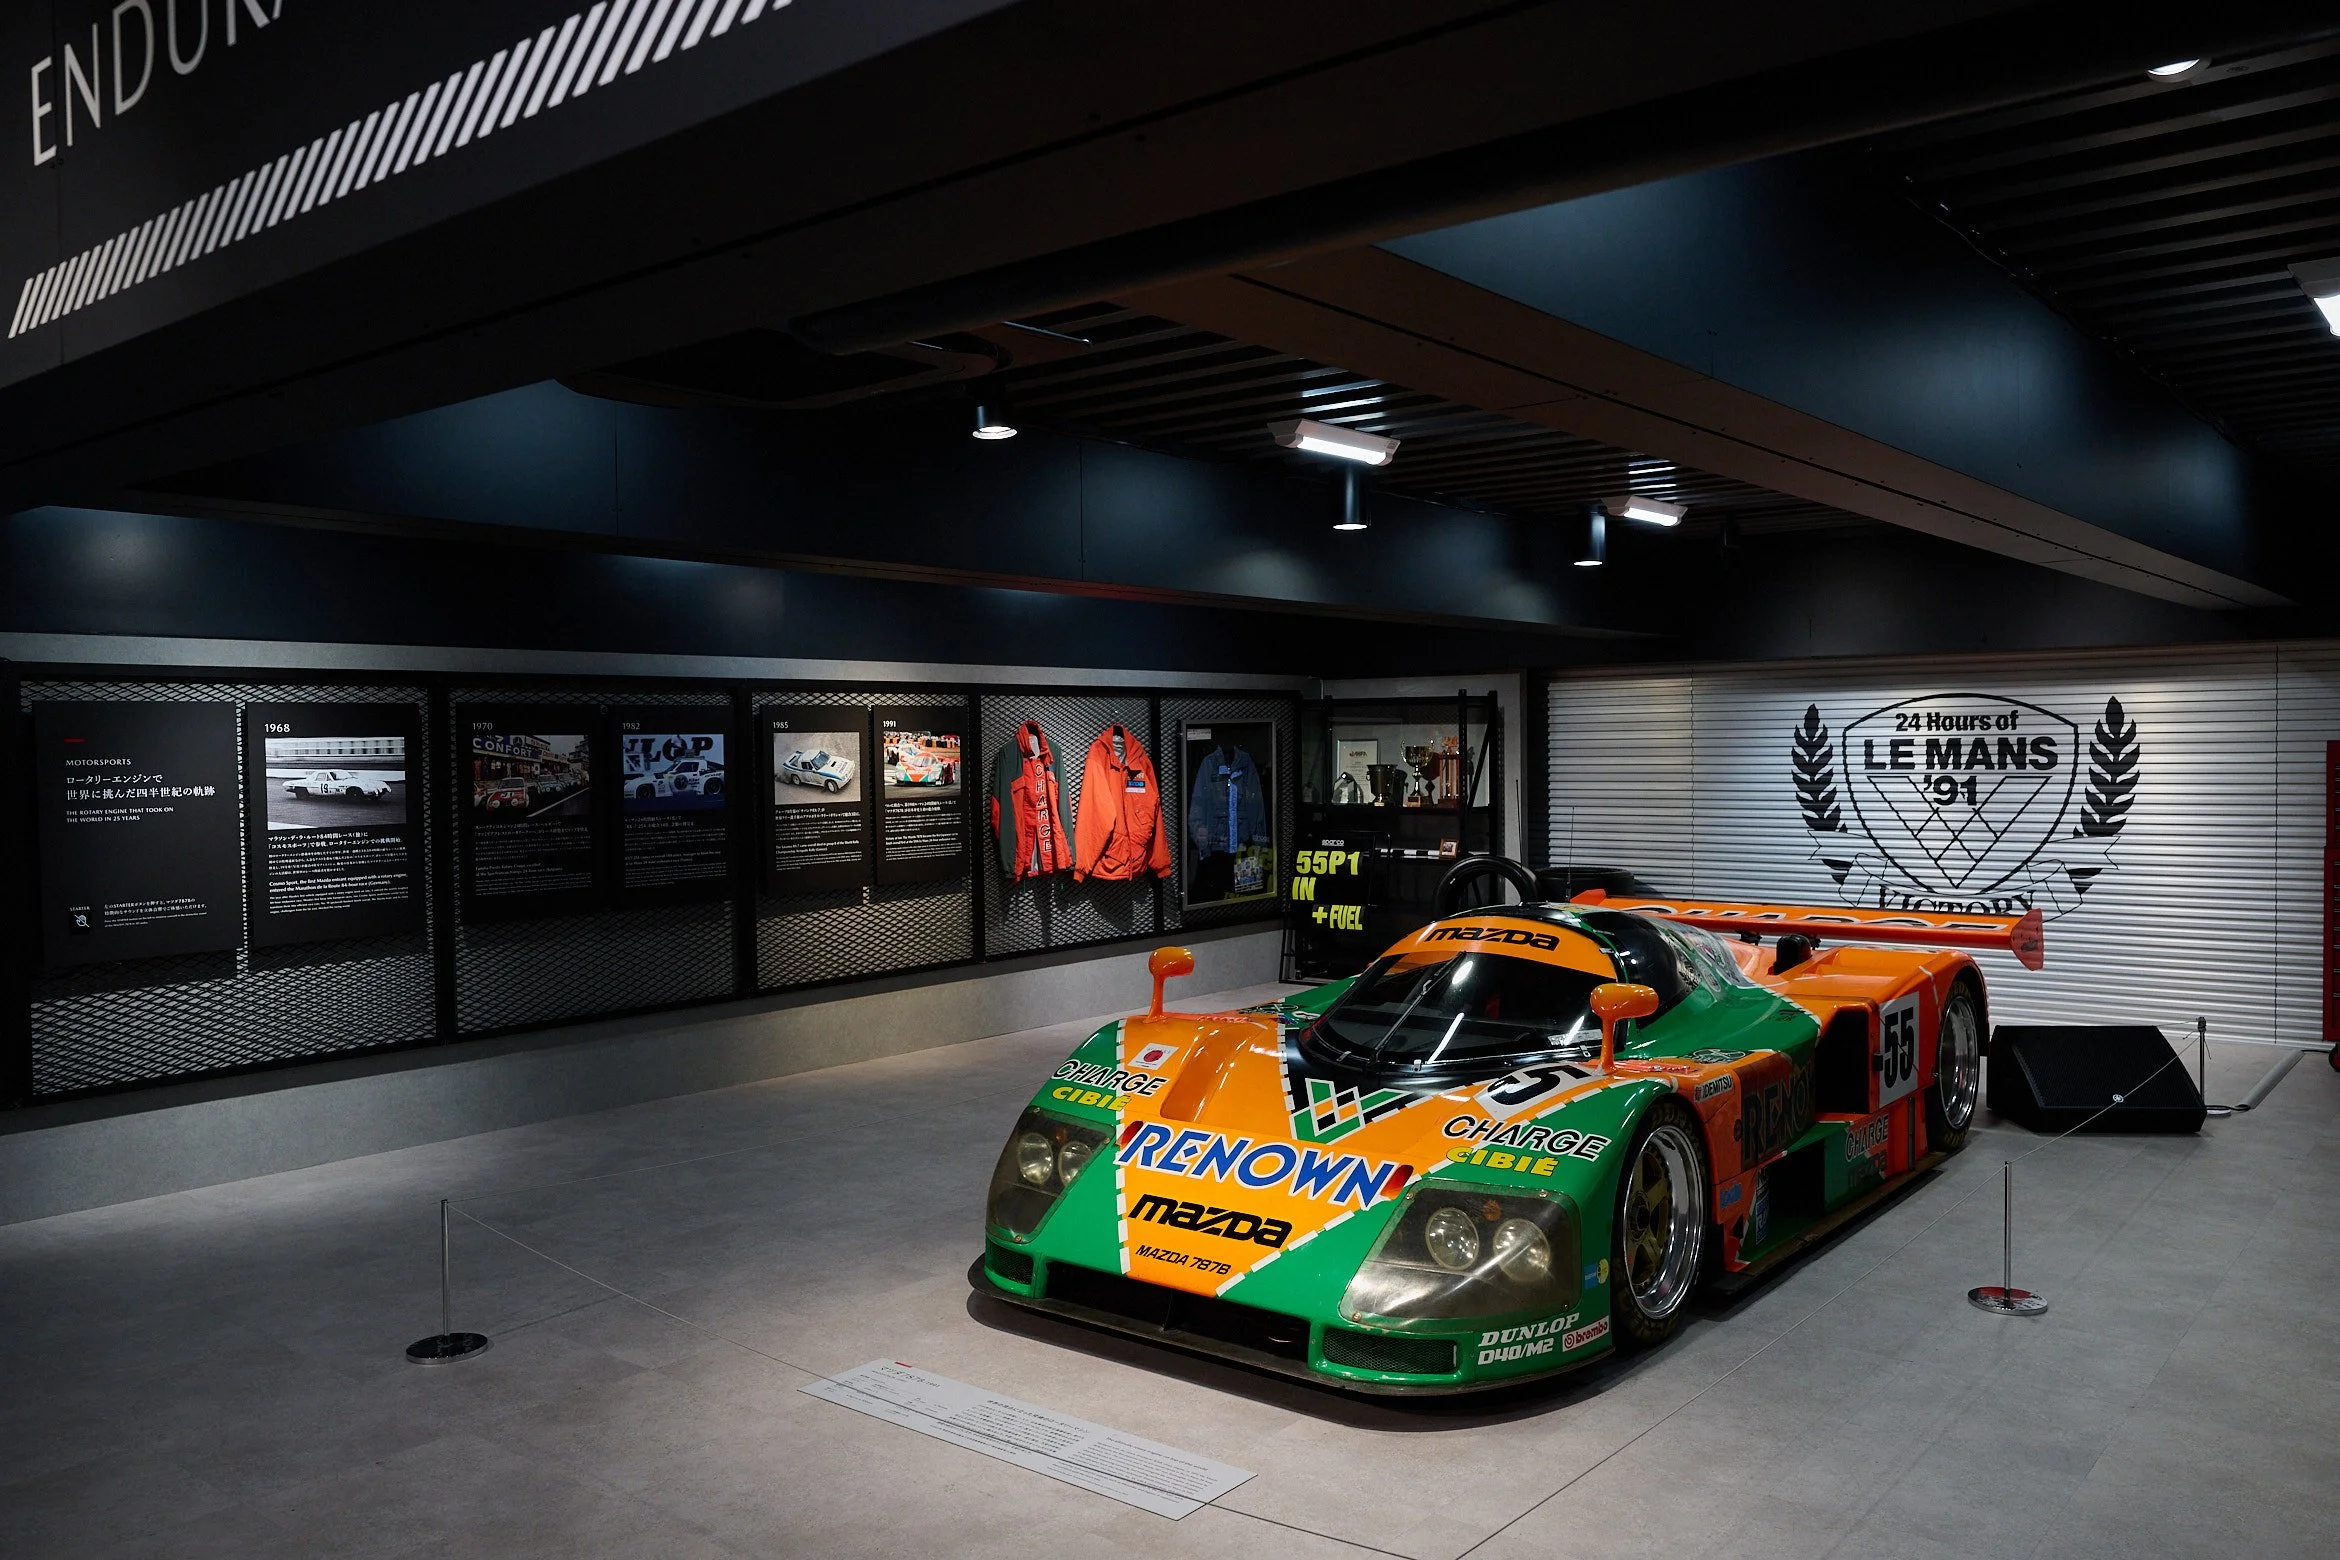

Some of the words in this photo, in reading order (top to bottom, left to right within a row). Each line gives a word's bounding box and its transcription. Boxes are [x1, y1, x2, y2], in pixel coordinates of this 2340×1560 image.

[31, 0, 284, 166] ENDU
[265, 723, 292, 734] 1968
[471, 722, 494, 731] 1970
[622, 722, 641, 731] 1982
[773, 722, 789, 730] 1985
[883, 720, 897, 729] 1991
[1895, 713, 1921, 732] 24
[1926, 711, 1992, 732] Hours
[1995, 710, 2020, 731] of
[472, 737, 536, 759] CONFORT
[1864, 738, 1915, 771] LE
[1925, 736, 2059, 771] MANS
[66, 758, 132, 767] MOTORSPORTS
[67, 774, 163, 785] ロータリーエンジンで
[67, 785, 217, 801] 世界に挑んだ四半世紀の軌跡
[1923, 774, 1978, 806] '91
[122, 814, 141, 822] YEARS
[1034, 764, 1052, 852] CHARGE
[1296, 851, 1361, 876] 55P1
[1292, 877, 1317, 901] IN
[1424, 926, 1560, 953] mazda
[1884, 1006, 1915, 1089] 55
[1051, 1058, 1171, 1098] CHARGE
[1442, 1113, 1613, 1162] CHARGE
[1846, 1114, 1888, 1162] CHARGE
[1113, 1120, 1395, 1212] RENOWN
[1446, 1146, 1560, 1177] CIBIÉ
[1128, 1193, 1293, 1249] mazda
[1135, 1243, 1188, 1267] MAZDA
[1189, 1255, 1233, 1276] 787B
[1478, 1312, 1580, 1348] DUNLOP
[1575, 1320, 1609, 1345] brembo
[1477, 1337, 1555, 1366] D40/M2
